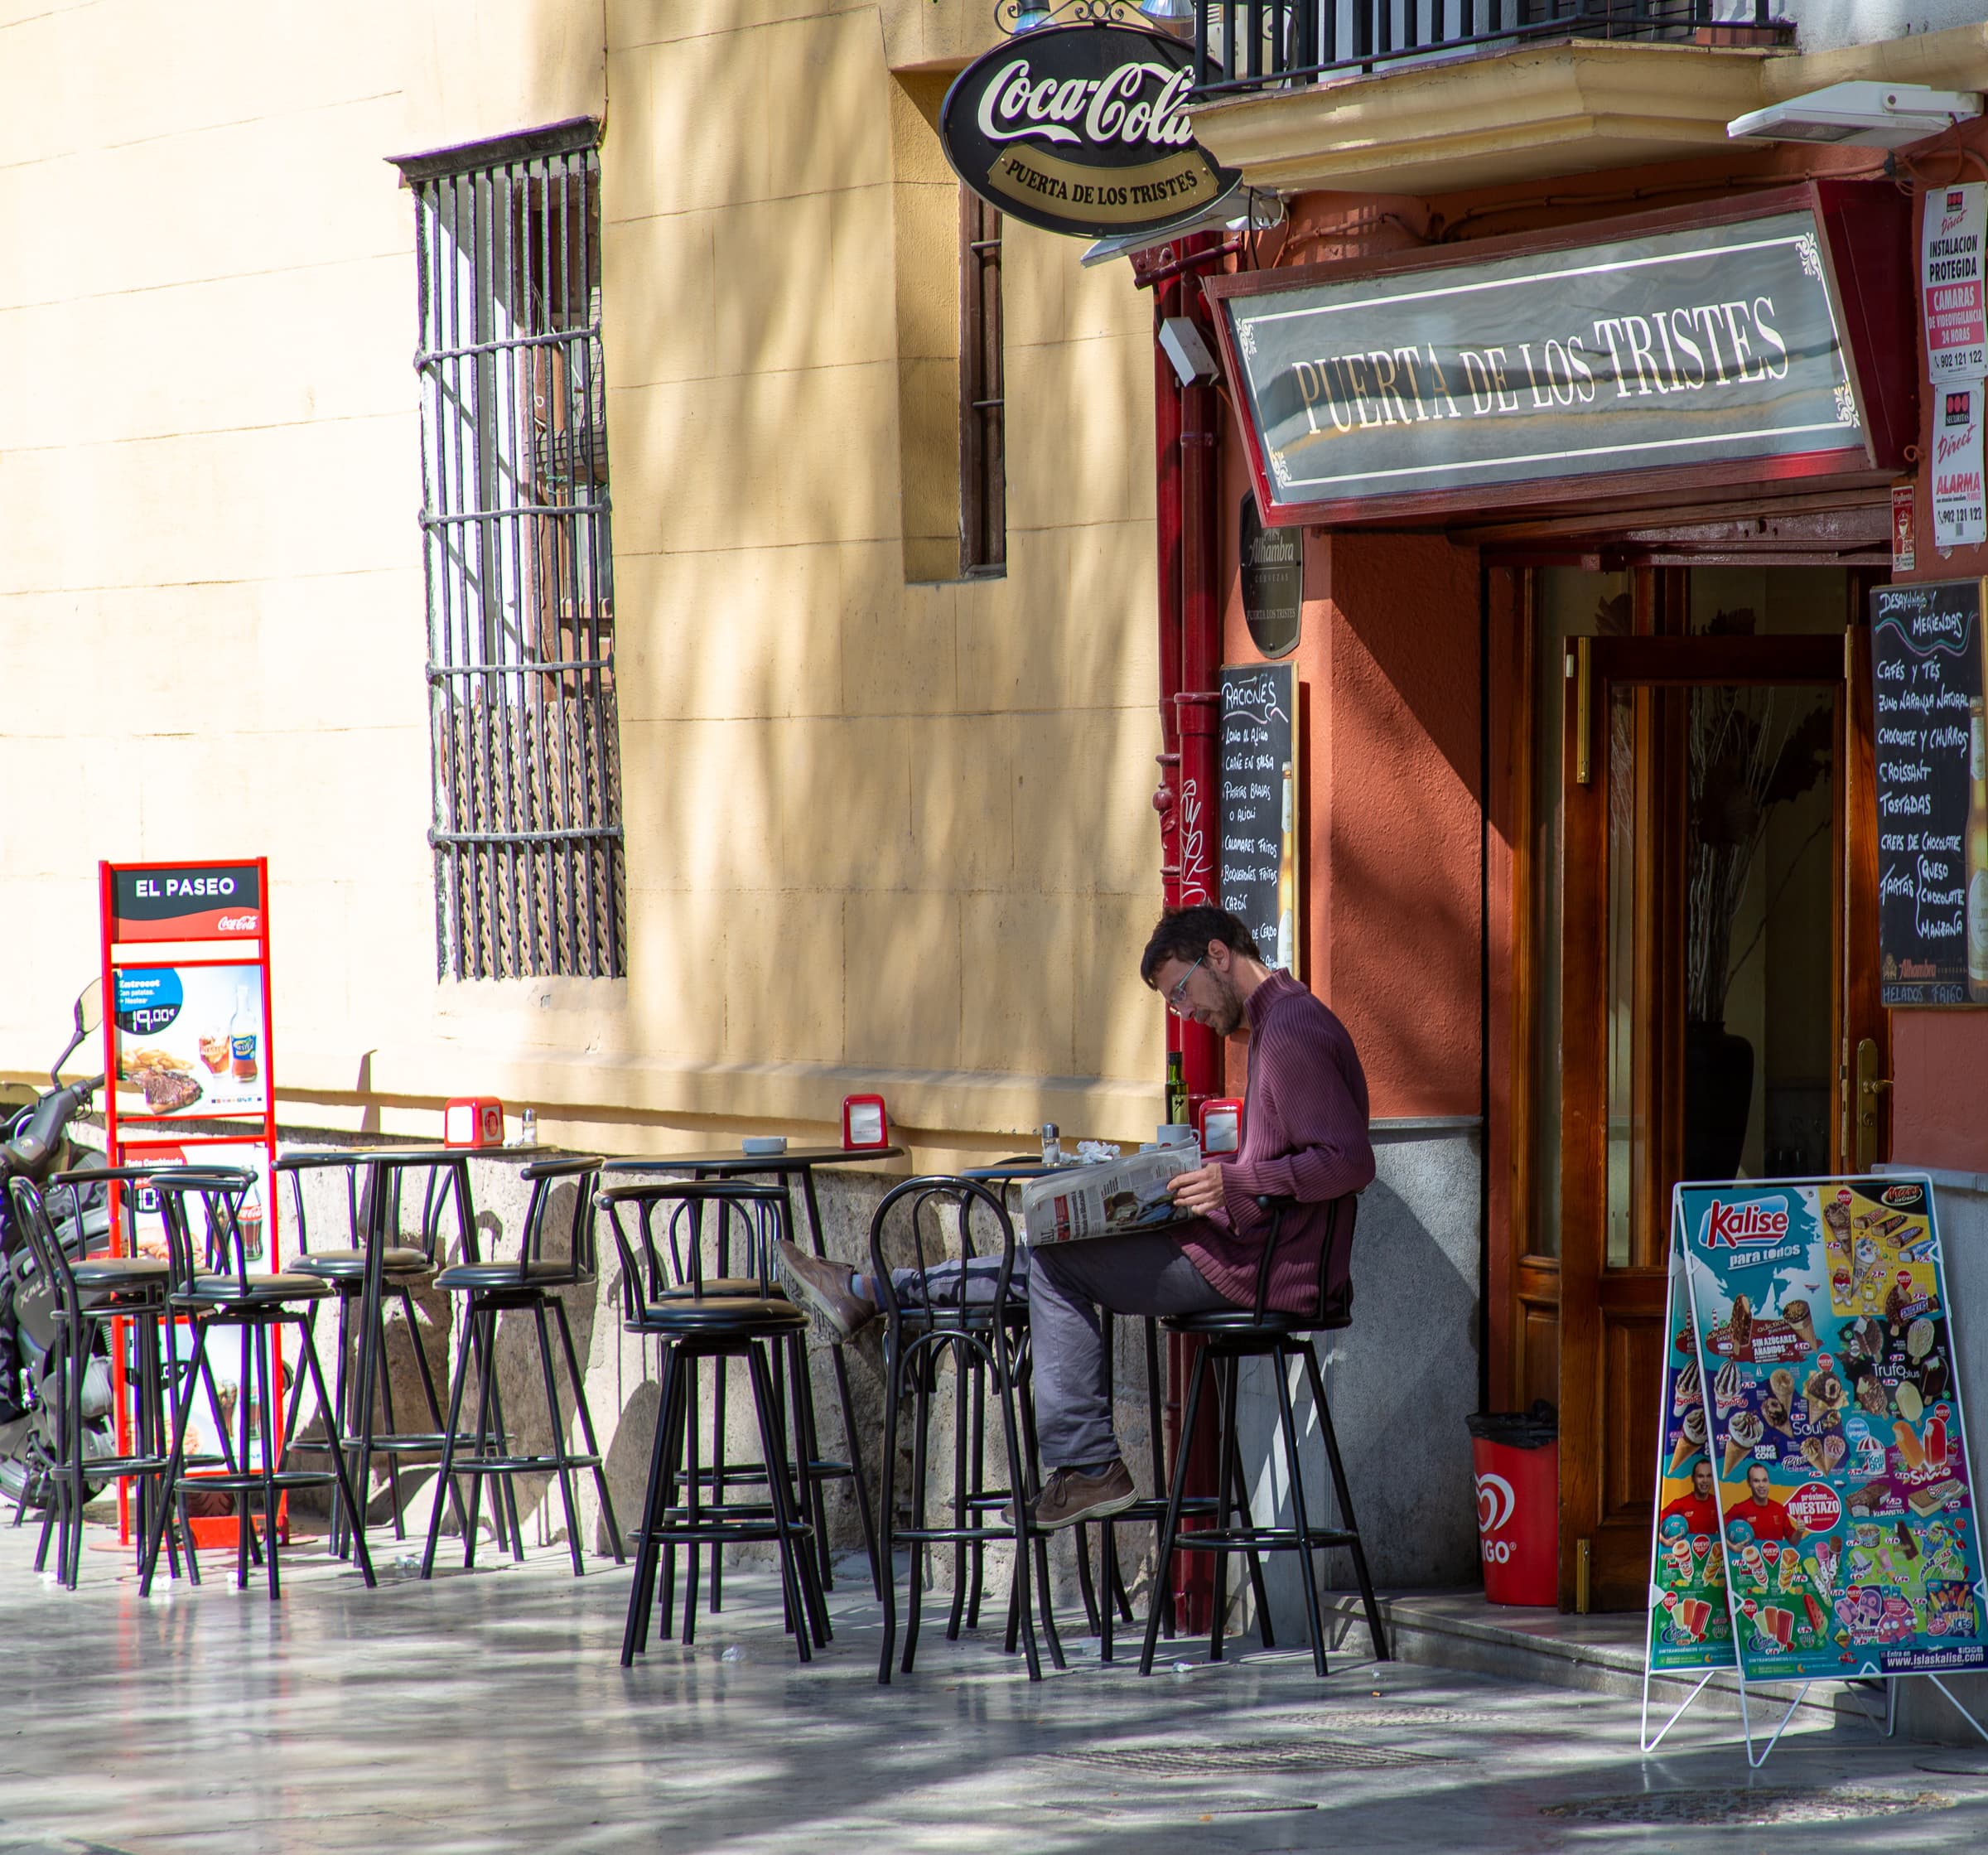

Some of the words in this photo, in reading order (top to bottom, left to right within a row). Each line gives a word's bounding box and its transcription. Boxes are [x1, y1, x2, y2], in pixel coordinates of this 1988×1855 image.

[978, 60, 1194, 144] Coca-Cola
[1006, 158, 1067, 200] PUERTA
[1072, 184, 1094, 203] DE
[1098, 186, 1127, 205] LOS
[1131, 170, 1198, 204] TRISTES
[1929, 234, 1977, 258] INSTALACION
[1929, 256, 1976, 283] PROTEGIDA
[1933, 285, 1975, 312] CAMARAS
[1928, 316, 1936, 330] DE
[1937, 308, 1983, 328] VIDEOVIGILANCIA
[1942, 330, 1950, 345] 24
[1951, 327, 1970, 344] HORAS
[1291, 342, 1462, 436] PUERTA
[1460, 348, 1511, 416] DE
[1519, 336, 1597, 408] LOS
[1594, 297, 1789, 398] TRISTES
[1941, 354, 1952, 368] 902
[1955, 351, 1966, 365] 121
[1970, 350, 1982, 364] 122
[1947, 414, 1970, 424] SECURITAS
[1937, 424, 1976, 464] Direct
[1936, 471, 1981, 495] ALARMA
[1943, 510, 1955, 524] 902
[1957, 508, 1967, 522] 121
[1970, 507, 1982, 521] 122
[1248, 535, 1294, 567] Alhambra
[1930, 591, 1937, 608] Y
[1267, 609, 1276, 619] LOS
[1276, 607, 1296, 618] TRISTES
[1913, 612, 1963, 639] MERIENDAS
[1877, 659, 1905, 681] CAFÉS
[1913, 666, 1918, 684] Y
[1922, 655, 1941, 682] TÉS
[1222, 682, 1276, 721] RACIONES
[1937, 683, 1969, 709] NATURAL
[1878, 727, 1917, 746] CHOCOLATE
[1920, 731, 1927, 752] Y
[1930, 725, 1969, 758] CHURROS
[1244, 755, 1254, 770] EN
[1257, 753, 1274, 771] SALSA
[1879, 759, 1932, 783] CROISSANT
[1224, 780, 1247, 801] PATATAS
[1251, 783, 1271, 801] BRAVAS
[1879, 790, 1932, 817] TOSTADAS
[1257, 838, 1276, 858] FRITOS
[1908, 833, 1919, 851] DE
[1922, 831, 1962, 853] CHOCOLATE
[1258, 866, 1277, 886] FRITOS
[1923, 859, 1948, 882] QUESO
[136, 880, 160, 897] EL
[166, 877, 235, 897] PASEO
[1879, 863, 1914, 906] TARTAS
[1921, 888, 1965, 906] CHOCOLATE
[218, 915, 258, 931] Coca-Cola
[1252, 928, 1258, 940] DE
[1260, 922, 1277, 941] CERDO
[1899, 958, 1937, 981] Alhambra
[1883, 986, 1923, 1003] HELADOS
[1707, 1200, 1788, 1249] Kalise
[1730, 1251, 1760, 1268] para
[1763, 1244, 1801, 1260] todos
[1788, 1500, 1840, 1515] INIESTAZO
[1480, 1540, 1510, 1564] IGO
[1887, 1652, 1984, 1668] www.islaskalise.com
